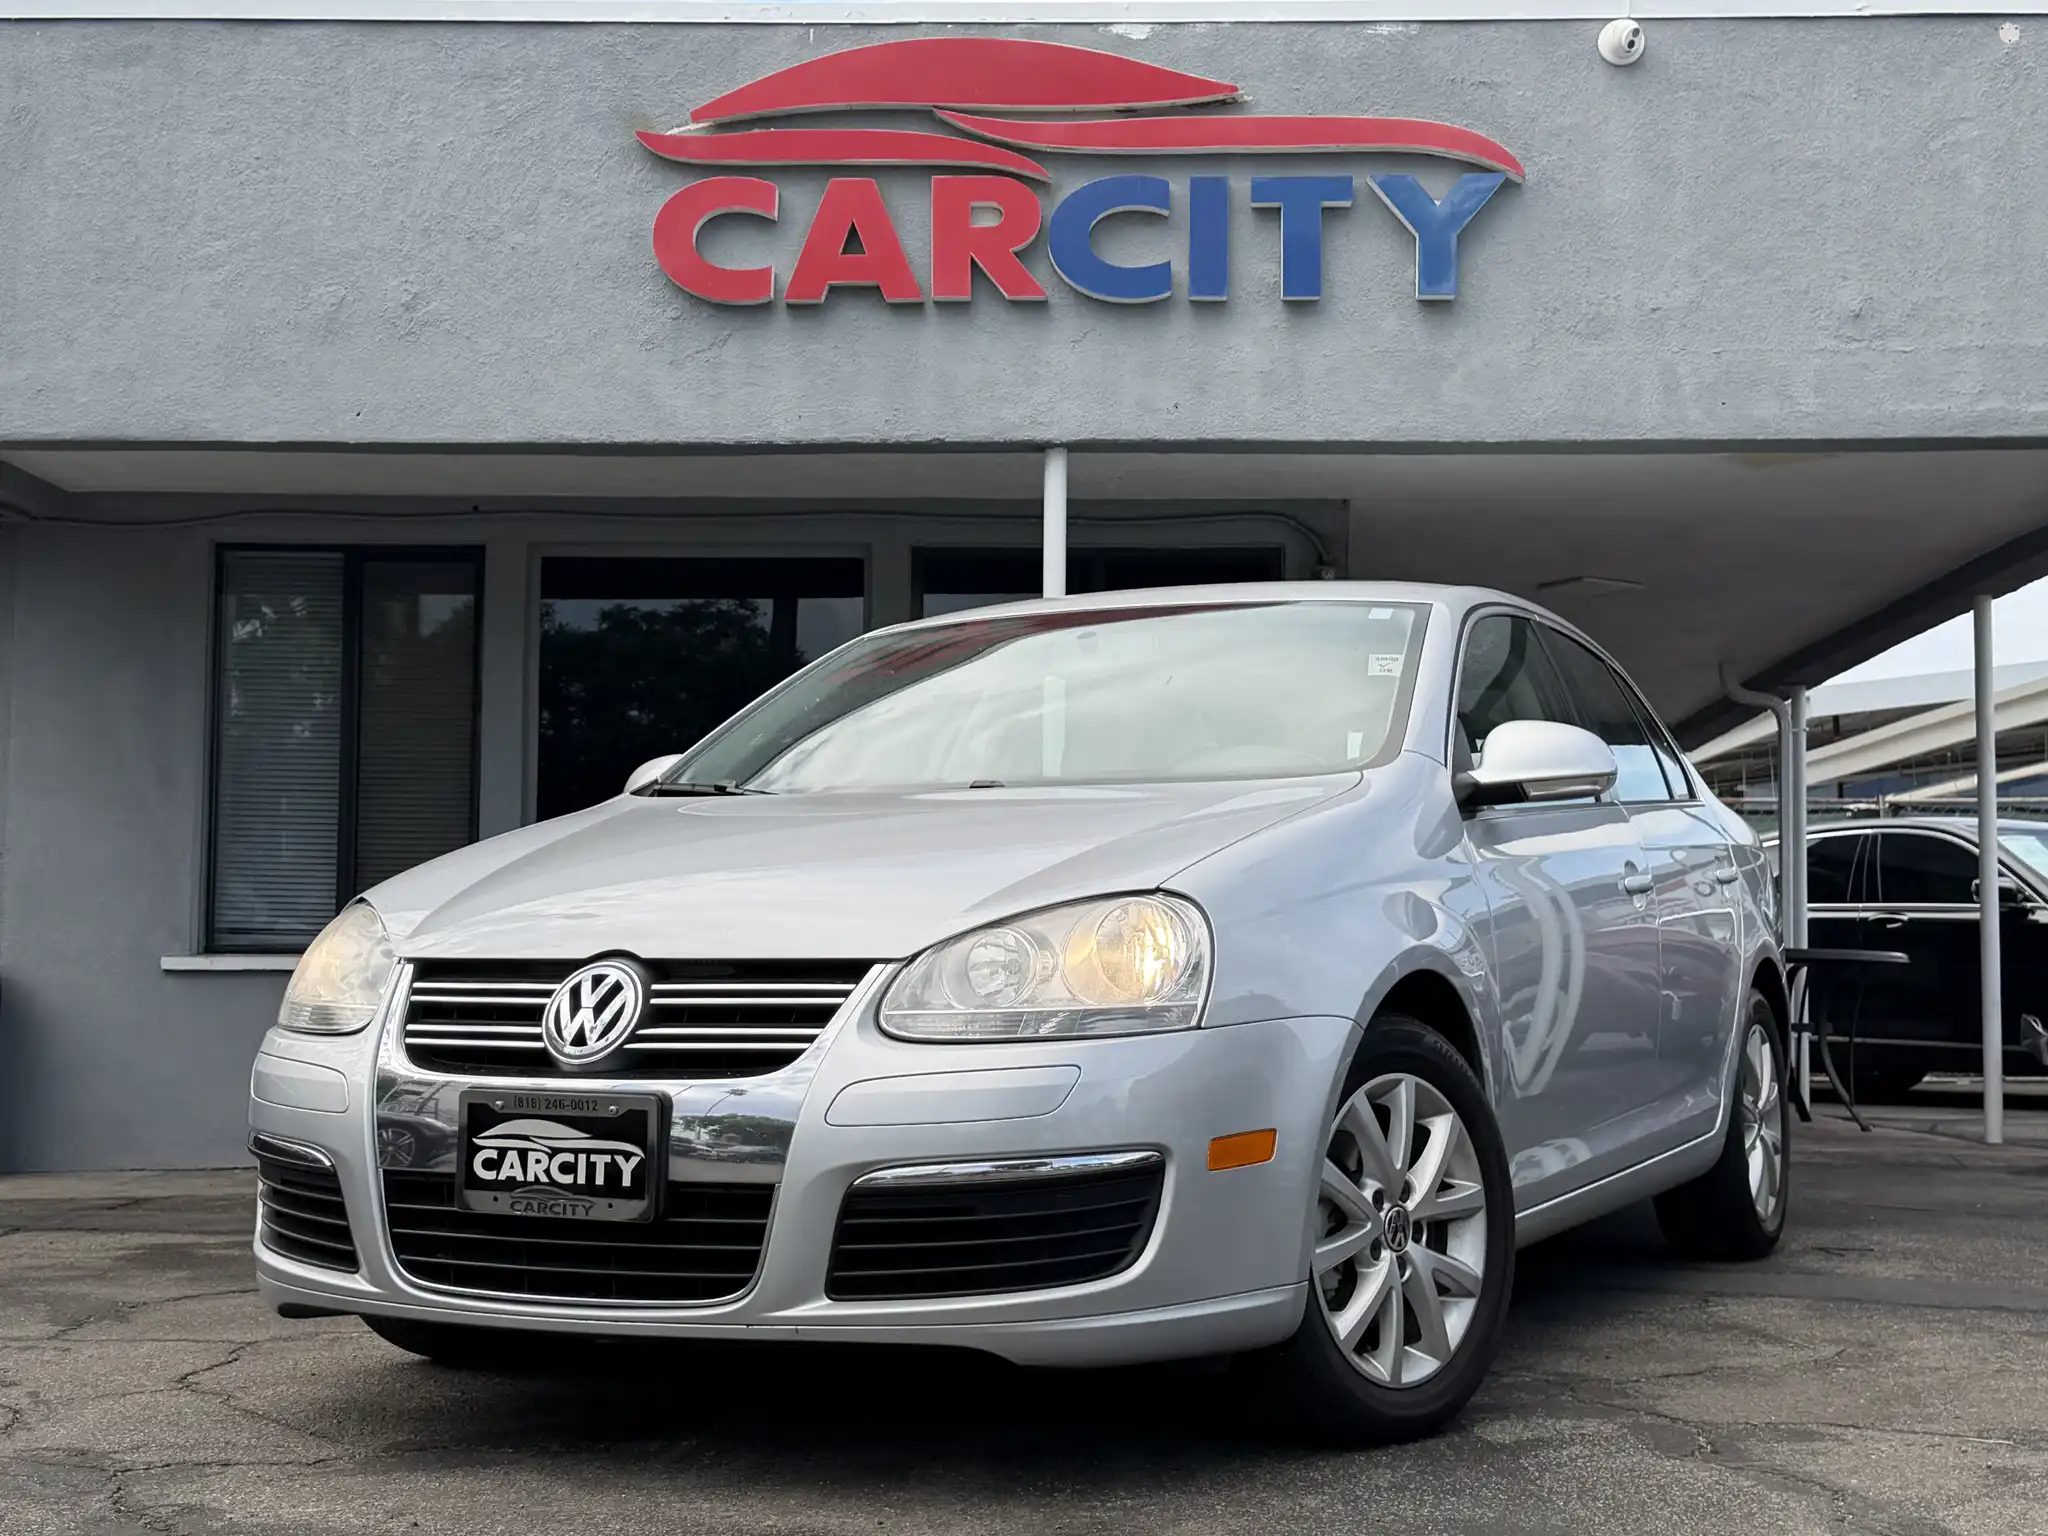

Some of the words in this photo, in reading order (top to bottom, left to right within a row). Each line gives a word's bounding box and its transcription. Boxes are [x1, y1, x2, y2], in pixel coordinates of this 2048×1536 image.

[653, 173, 1506, 304] CARCITY
[551, 967, 634, 1054] VW
[513, 1095, 541, 1109] (818)
[545, 1098, 599, 1112] 246-0012
[473, 1148, 642, 1187] CARCITY
[509, 1200, 595, 1217] CARCITY
